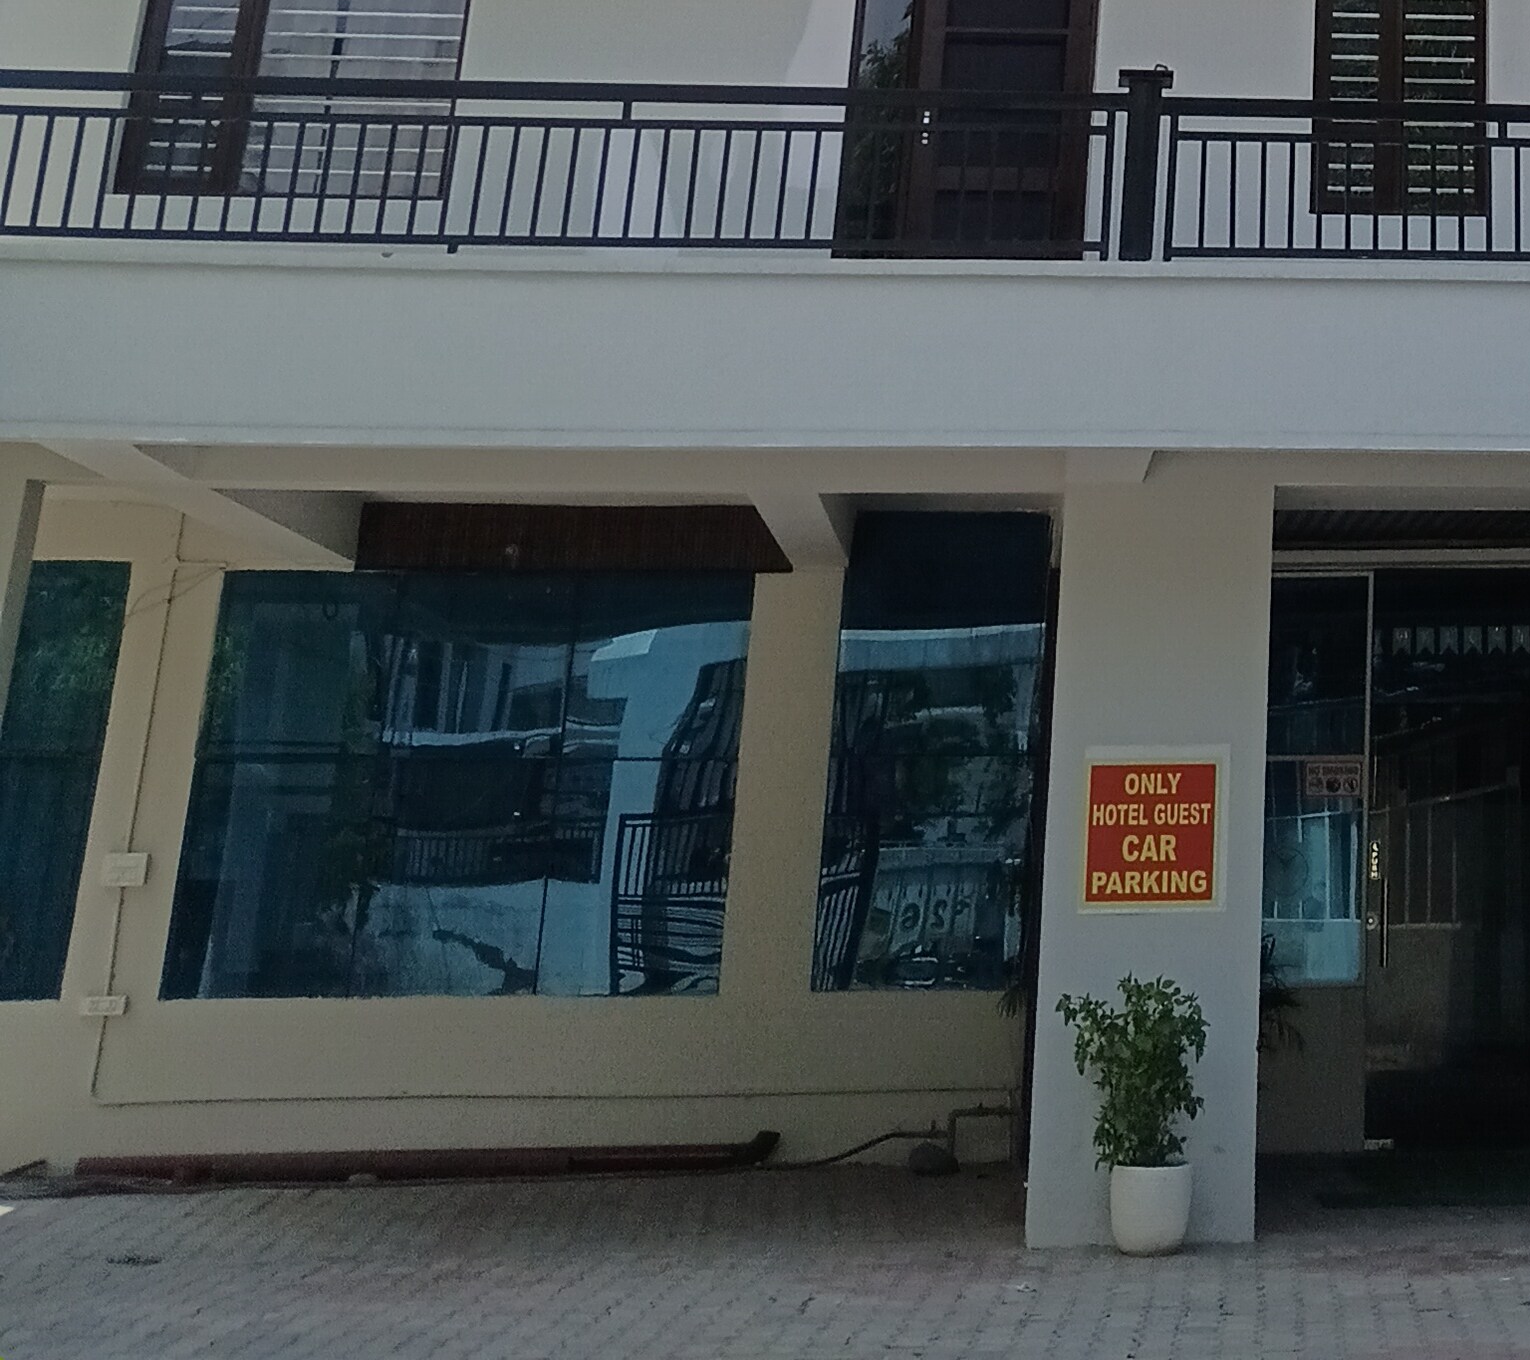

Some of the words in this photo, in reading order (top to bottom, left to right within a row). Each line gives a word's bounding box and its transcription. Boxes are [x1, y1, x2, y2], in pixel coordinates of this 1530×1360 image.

[1125, 773, 1182, 795] ONLY
[1092, 804, 1148, 826] HOTEL
[1154, 803, 1211, 825] GUEST
[1122, 834, 1176, 862] CAR
[1091, 870, 1207, 894] PARKING
